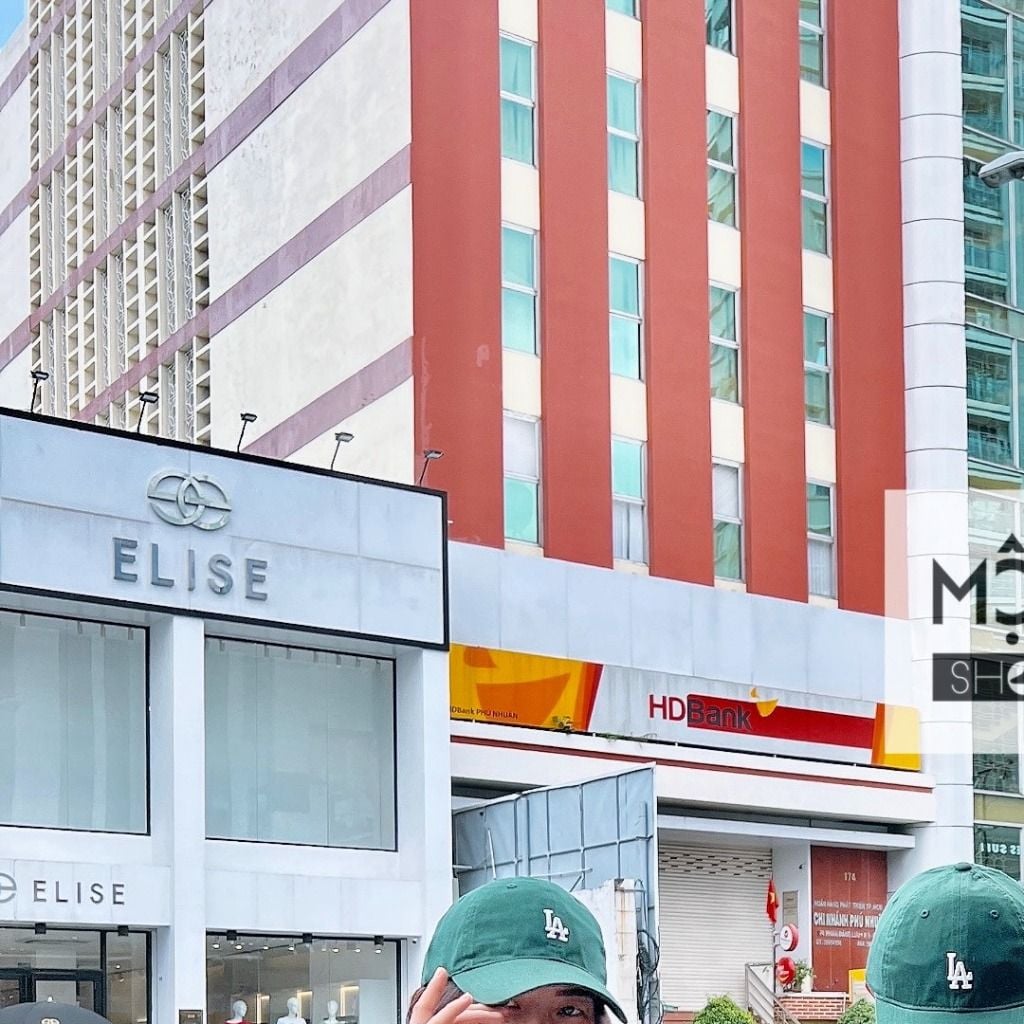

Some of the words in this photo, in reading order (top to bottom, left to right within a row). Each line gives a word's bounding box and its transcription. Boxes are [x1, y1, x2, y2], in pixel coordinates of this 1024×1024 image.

[112, 537, 268, 602] ELISE
[649, 694, 752, 730] HDBank
[33, 879, 125, 905] ELISE
[543, 908, 570, 942] LA
[946, 952, 973, 990] LA
